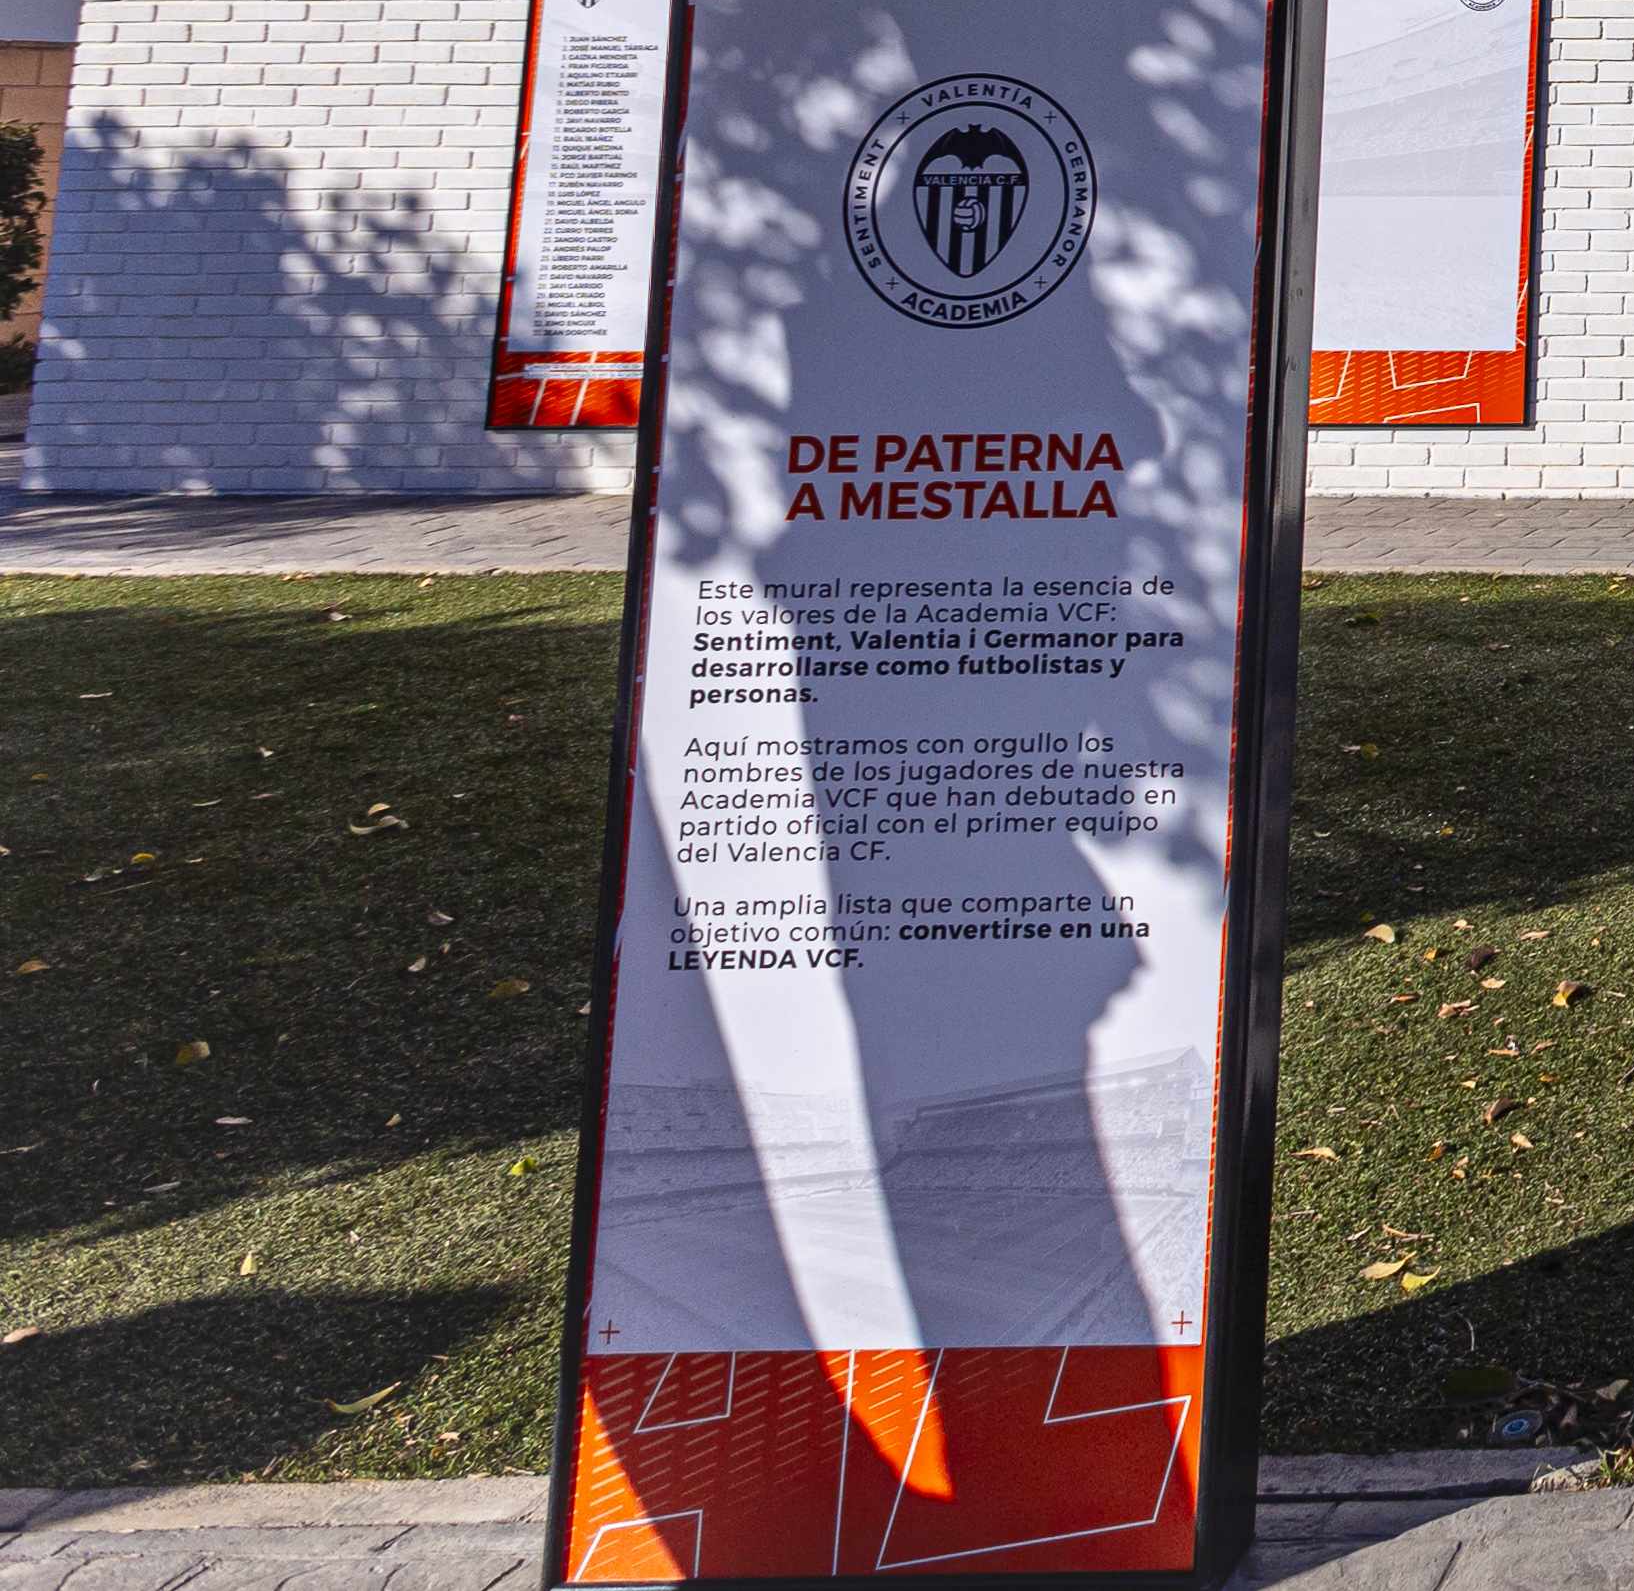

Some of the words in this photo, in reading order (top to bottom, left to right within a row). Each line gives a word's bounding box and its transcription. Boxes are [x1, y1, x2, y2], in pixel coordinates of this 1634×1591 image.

[921, 83, 1033, 109] VALENTÍA
[924, 176, 992, 185] VALENCIA
[854, 139, 885, 269] SENTIMENT
[1052, 141, 1088, 268] GERMANOR
[902, 291, 1028, 321] ACADEMIA
[788, 435, 859, 474] DE
[876, 433, 1124, 473] PATERNA
[785, 482, 820, 521] A
[840, 479, 1118, 520] MESTALLA
[698, 581, 753, 599] Este
[764, 578, 840, 599] mural
[850, 579, 993, 604] representa
[1002, 576, 1024, 597] la
[1034, 577, 1132, 597] esencia
[1142, 575, 1175, 596] de
[696, 606, 732, 626] los
[741, 605, 835, 625] valores
[843, 602, 876, 623] de
[885, 603, 907, 624] la
[915, 602, 1048, 623] Academia
[1057, 602, 1117, 622] VCF:
[693, 631, 842, 652] Sentiment,
[850, 629, 961, 650] Valentia
[968, 628, 977, 649] i
[984, 630, 1118, 649] Germanor
[1125, 632, 1184, 652] para
[691, 656, 869, 678] desarrollarse
[876, 660, 950, 676] como
[957, 654, 1103, 675] futbolistas
[1109, 658, 1126, 679] y
[689, 687, 818, 708] personas.
[684, 736, 749, 761] Aquí
[757, 738, 908, 756] mostramos
[916, 738, 964, 755] con
[973, 733, 1068, 760] orgullo
[1078, 732, 1114, 754] los
[684, 763, 803, 783] nombres
[810, 761, 845, 782] de
[854, 760, 891, 782] los
[895, 760, 1033, 786] jugadores
[1041, 758, 1075, 780] de
[1083, 760, 1184, 779] nuestra
[680, 788, 815, 810] Academia
[826, 787, 879, 809] VCF
[886, 791, 937, 812] que
[947, 786, 996, 806] han
[1005, 785, 1135, 806] debutado
[1144, 789, 1176, 805] en
[679, 815, 777, 840] partido
[786, 813, 868, 835] oficial
[876, 818, 925, 834] con
[933, 812, 957, 834] el
[966, 812, 1057, 837] primer
[1065, 811, 1158, 836] equipo
[677, 842, 718, 863] del
[727, 841, 840, 862] Valencia
[850, 840, 891, 861] CF.
[673, 896, 725, 921] Una
[735, 894, 827, 919] amplia
[837, 893, 892, 915] lista
[901, 897, 953, 919] que
[961, 894, 1092, 917] comparte
[1101, 895, 1134, 912] un
[670, 922, 780, 948] objetivo
[789, 920, 890, 942] común:
[899, 919, 1052, 940] convertirse
[1059, 922, 1092, 939] en
[1100, 922, 1150, 939] una
[668, 949, 797, 971] LEYENDA
[806, 948, 864, 968] VCF.
